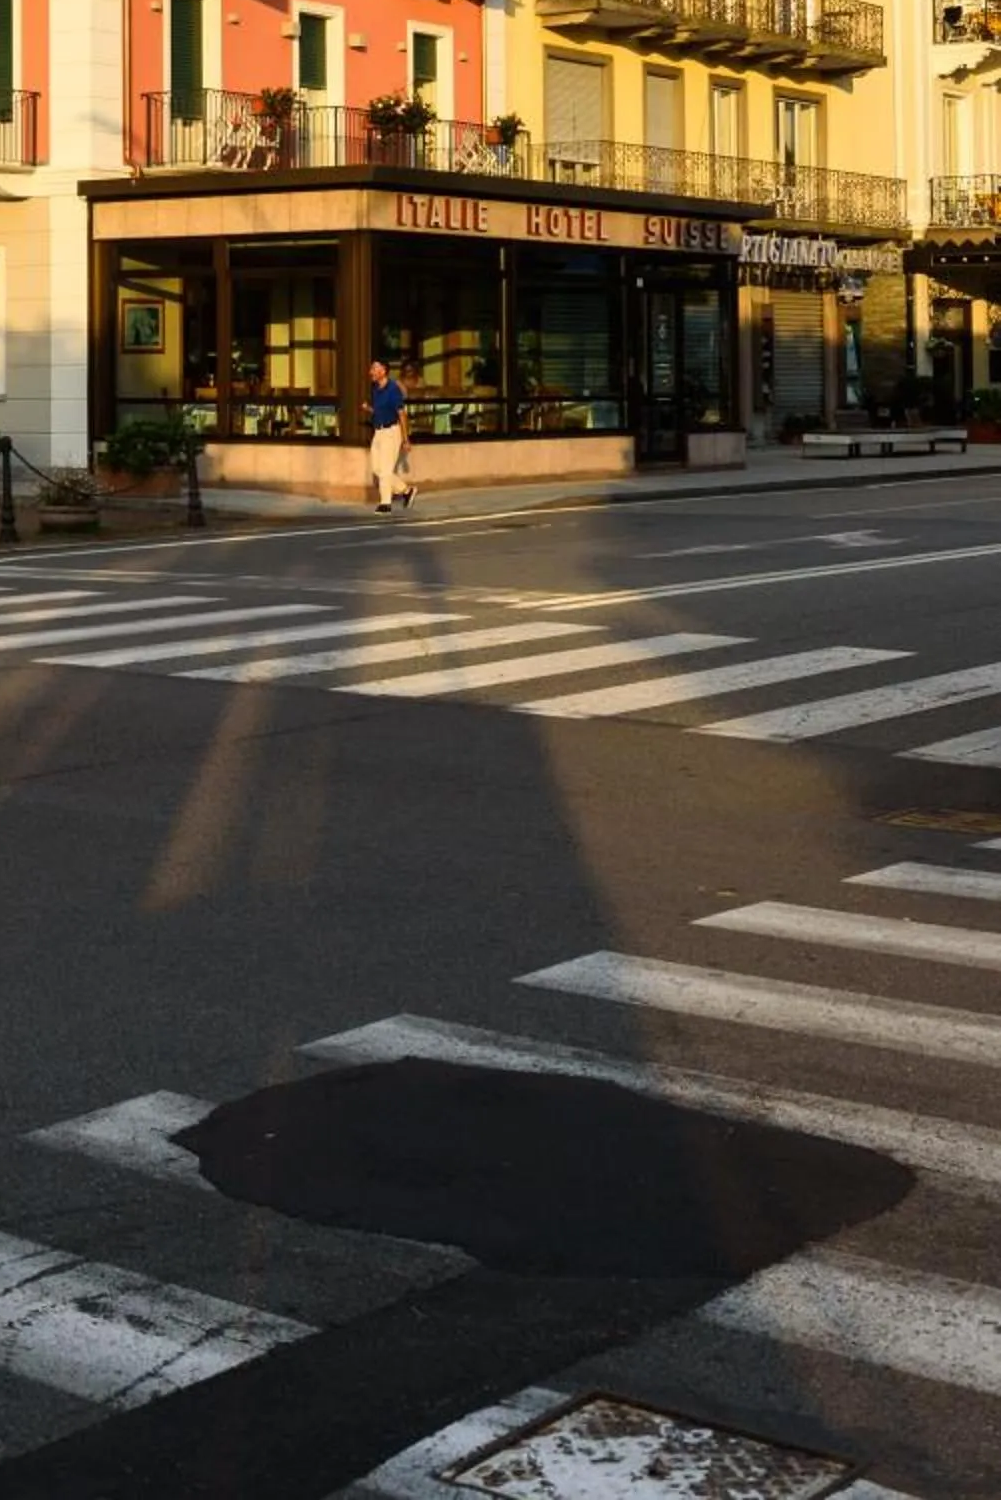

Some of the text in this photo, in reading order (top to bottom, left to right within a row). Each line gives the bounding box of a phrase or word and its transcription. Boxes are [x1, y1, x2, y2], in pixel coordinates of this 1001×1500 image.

[397, 194, 731, 249] ITALIE HOTEL SUISSE
